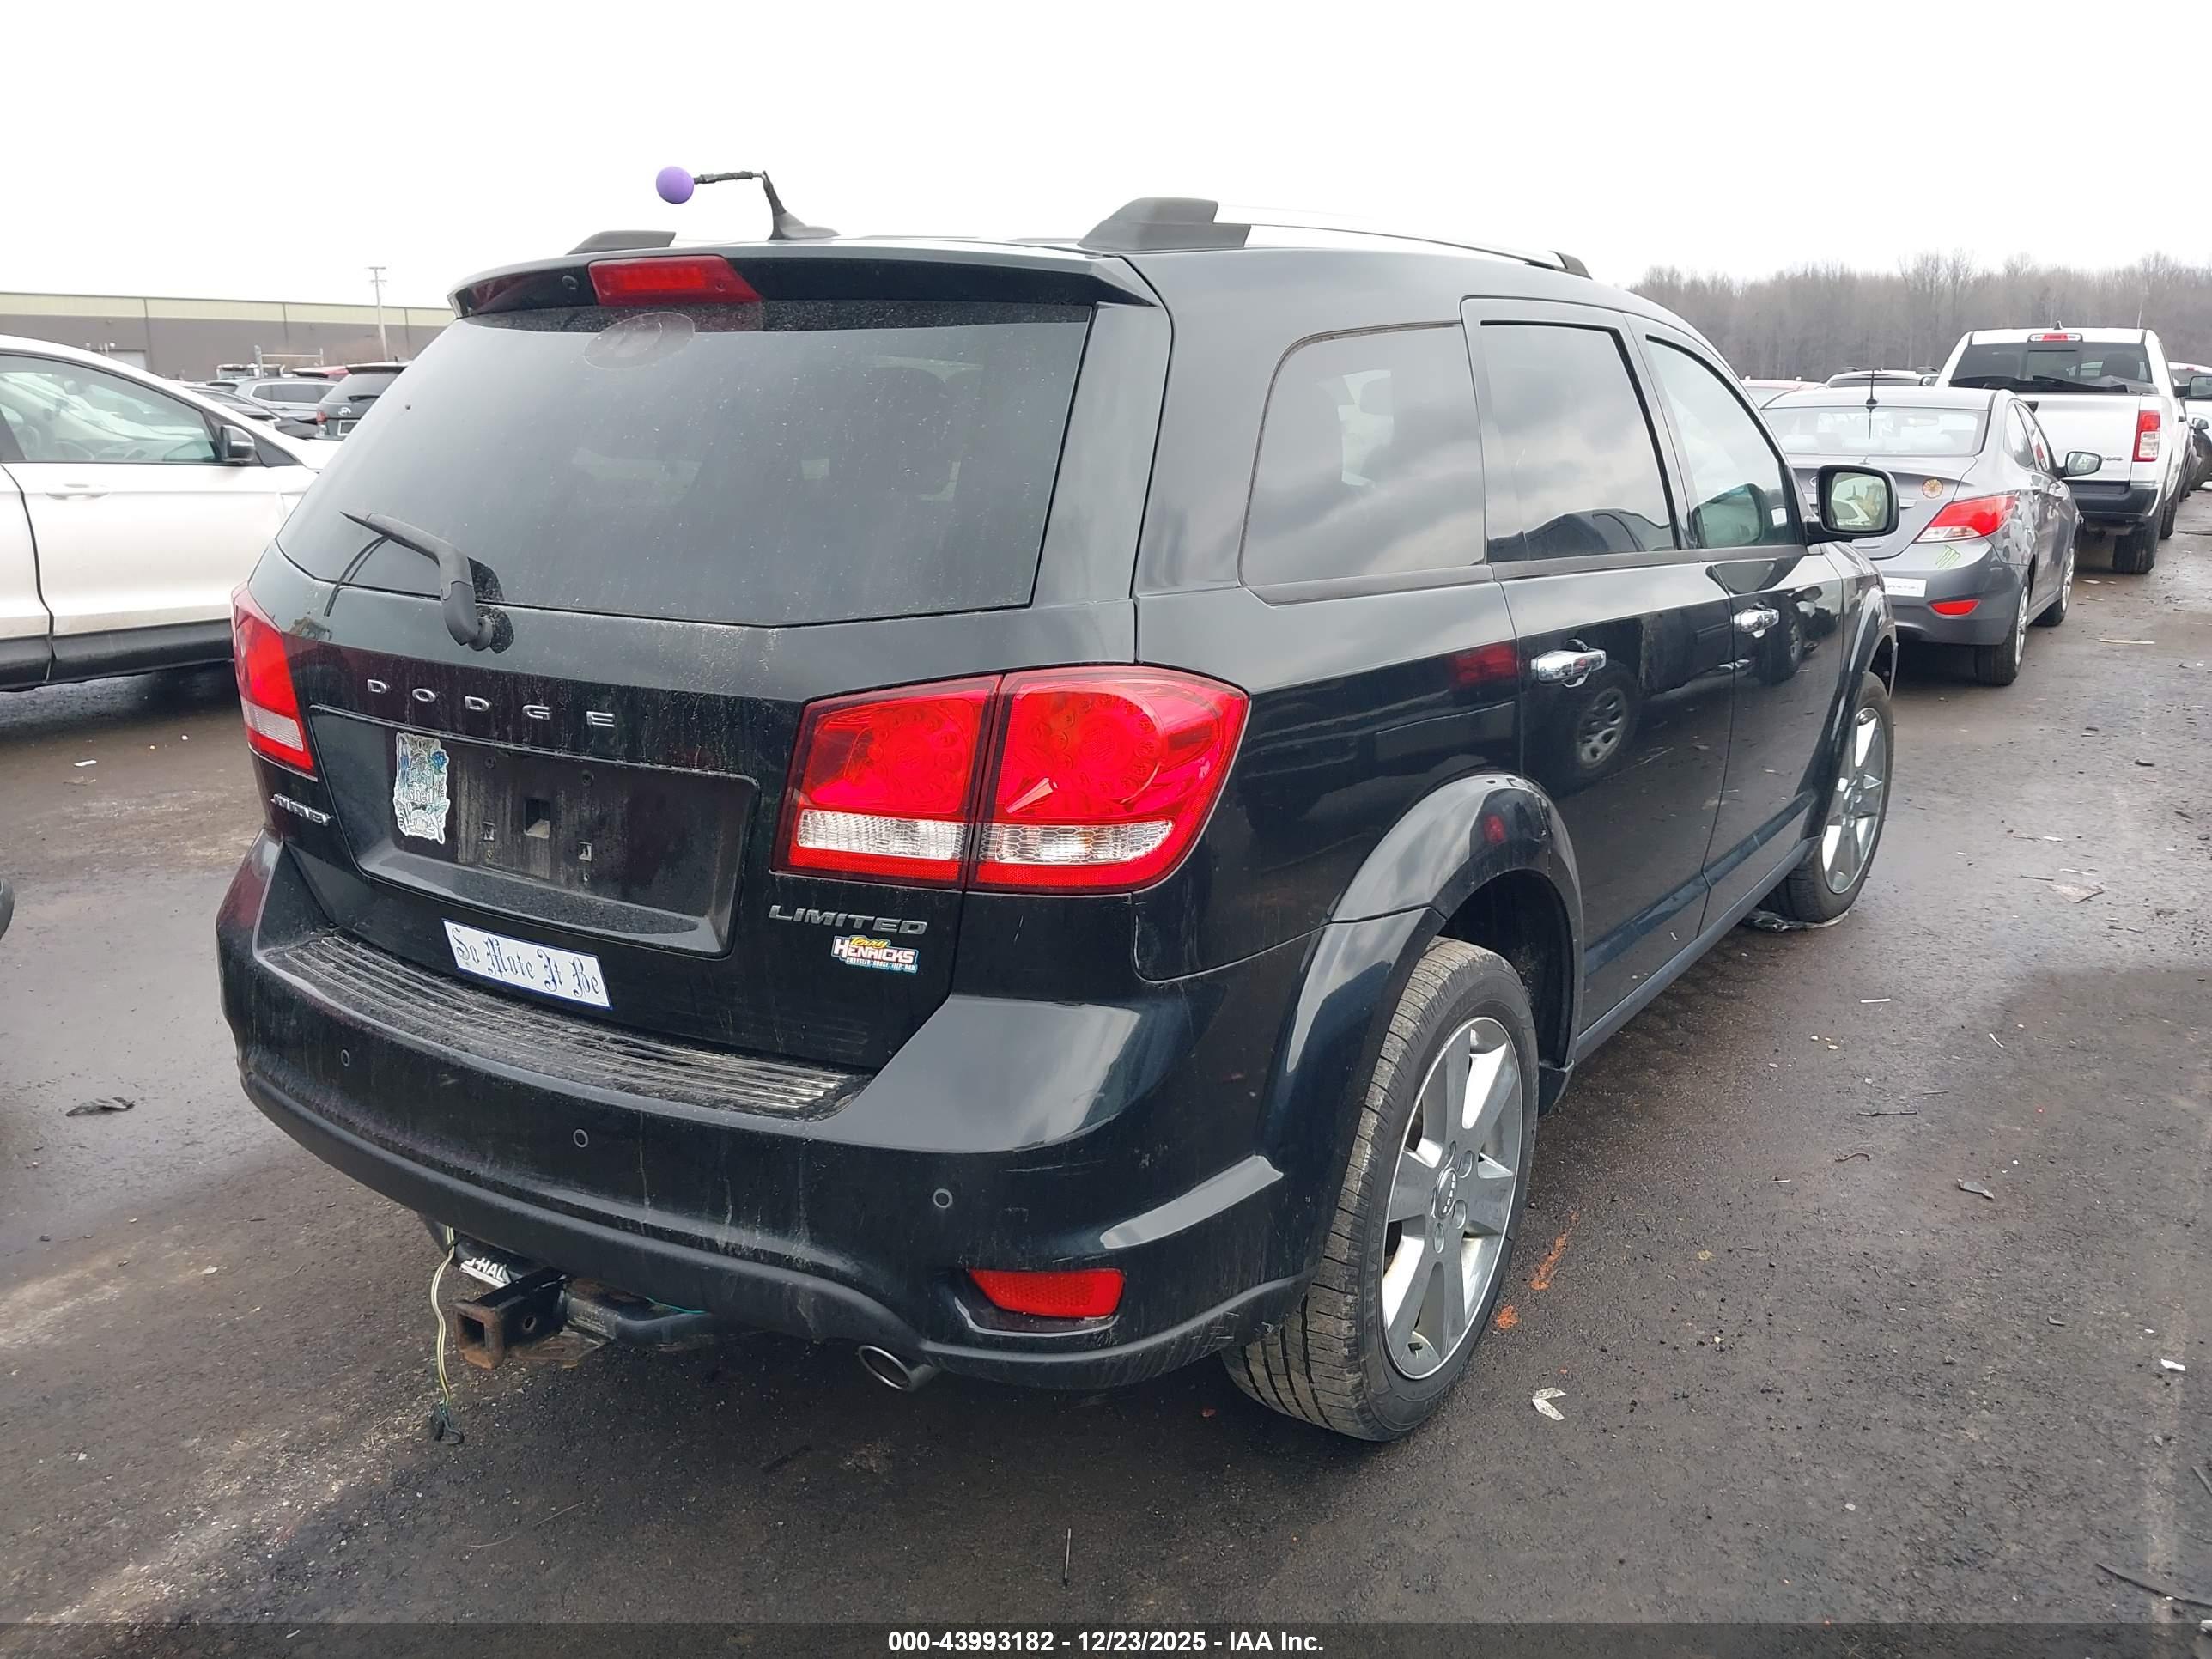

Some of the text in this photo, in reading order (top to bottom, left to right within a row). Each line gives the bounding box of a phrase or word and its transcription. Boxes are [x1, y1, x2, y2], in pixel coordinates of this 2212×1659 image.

[367, 679, 615, 728] DODGE
[769, 905, 927, 934] LIMITED
[483, 936, 535, 980] Mote
[537, 948, 562, 992] It
[569, 956, 600, 999] Be
[833, 938, 916, 963] HENRICKS
